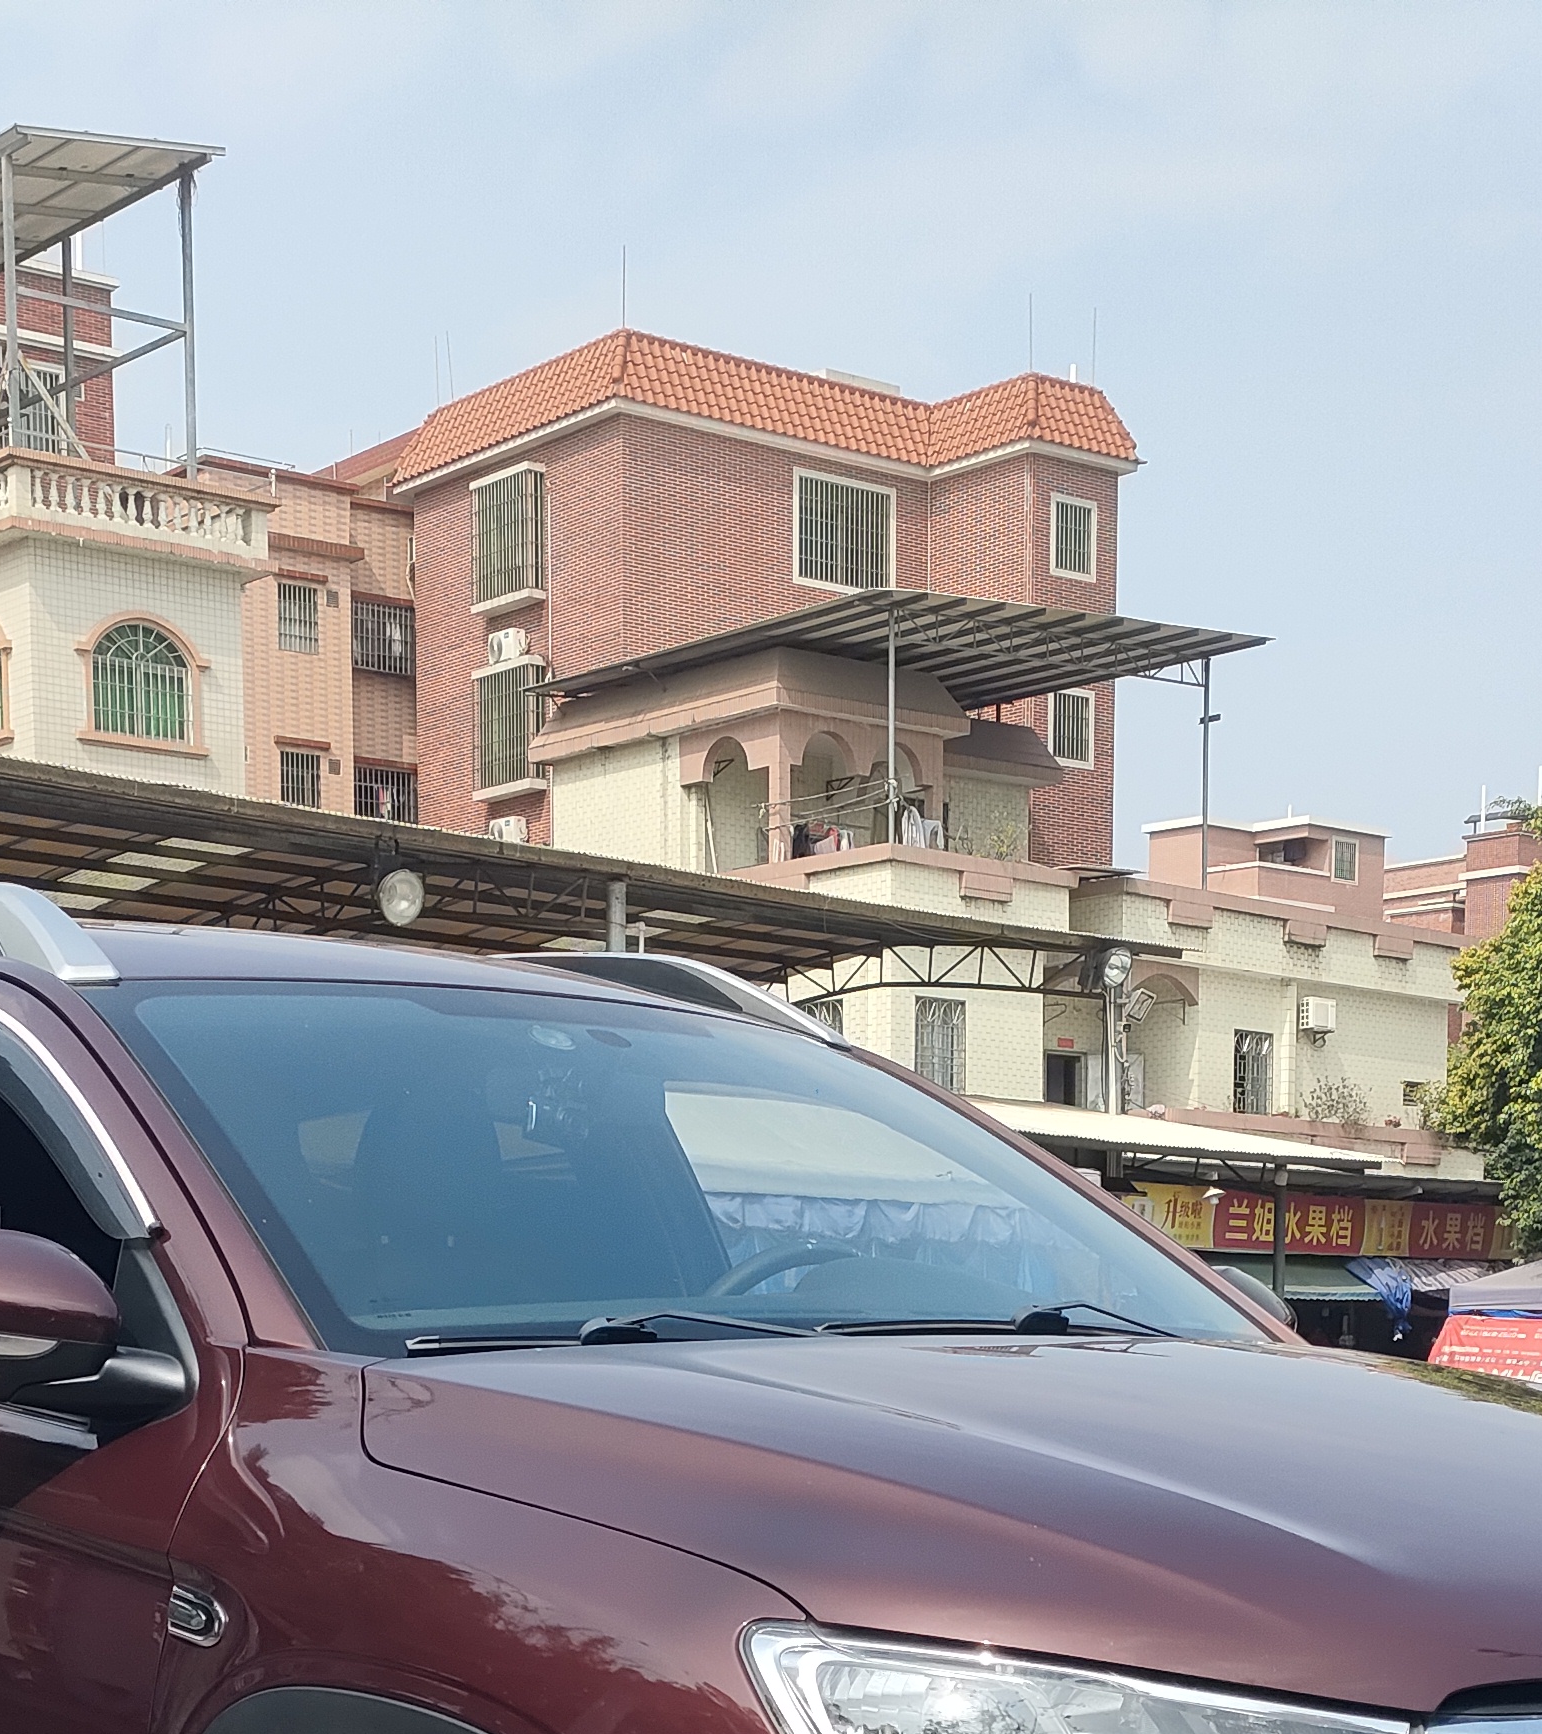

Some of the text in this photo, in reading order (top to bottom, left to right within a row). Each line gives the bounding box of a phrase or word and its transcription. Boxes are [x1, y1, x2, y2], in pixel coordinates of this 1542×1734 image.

[1225, 1198, 1353, 1247] 兰姐水果档
[1419, 1210, 1486, 1251] 水果档
